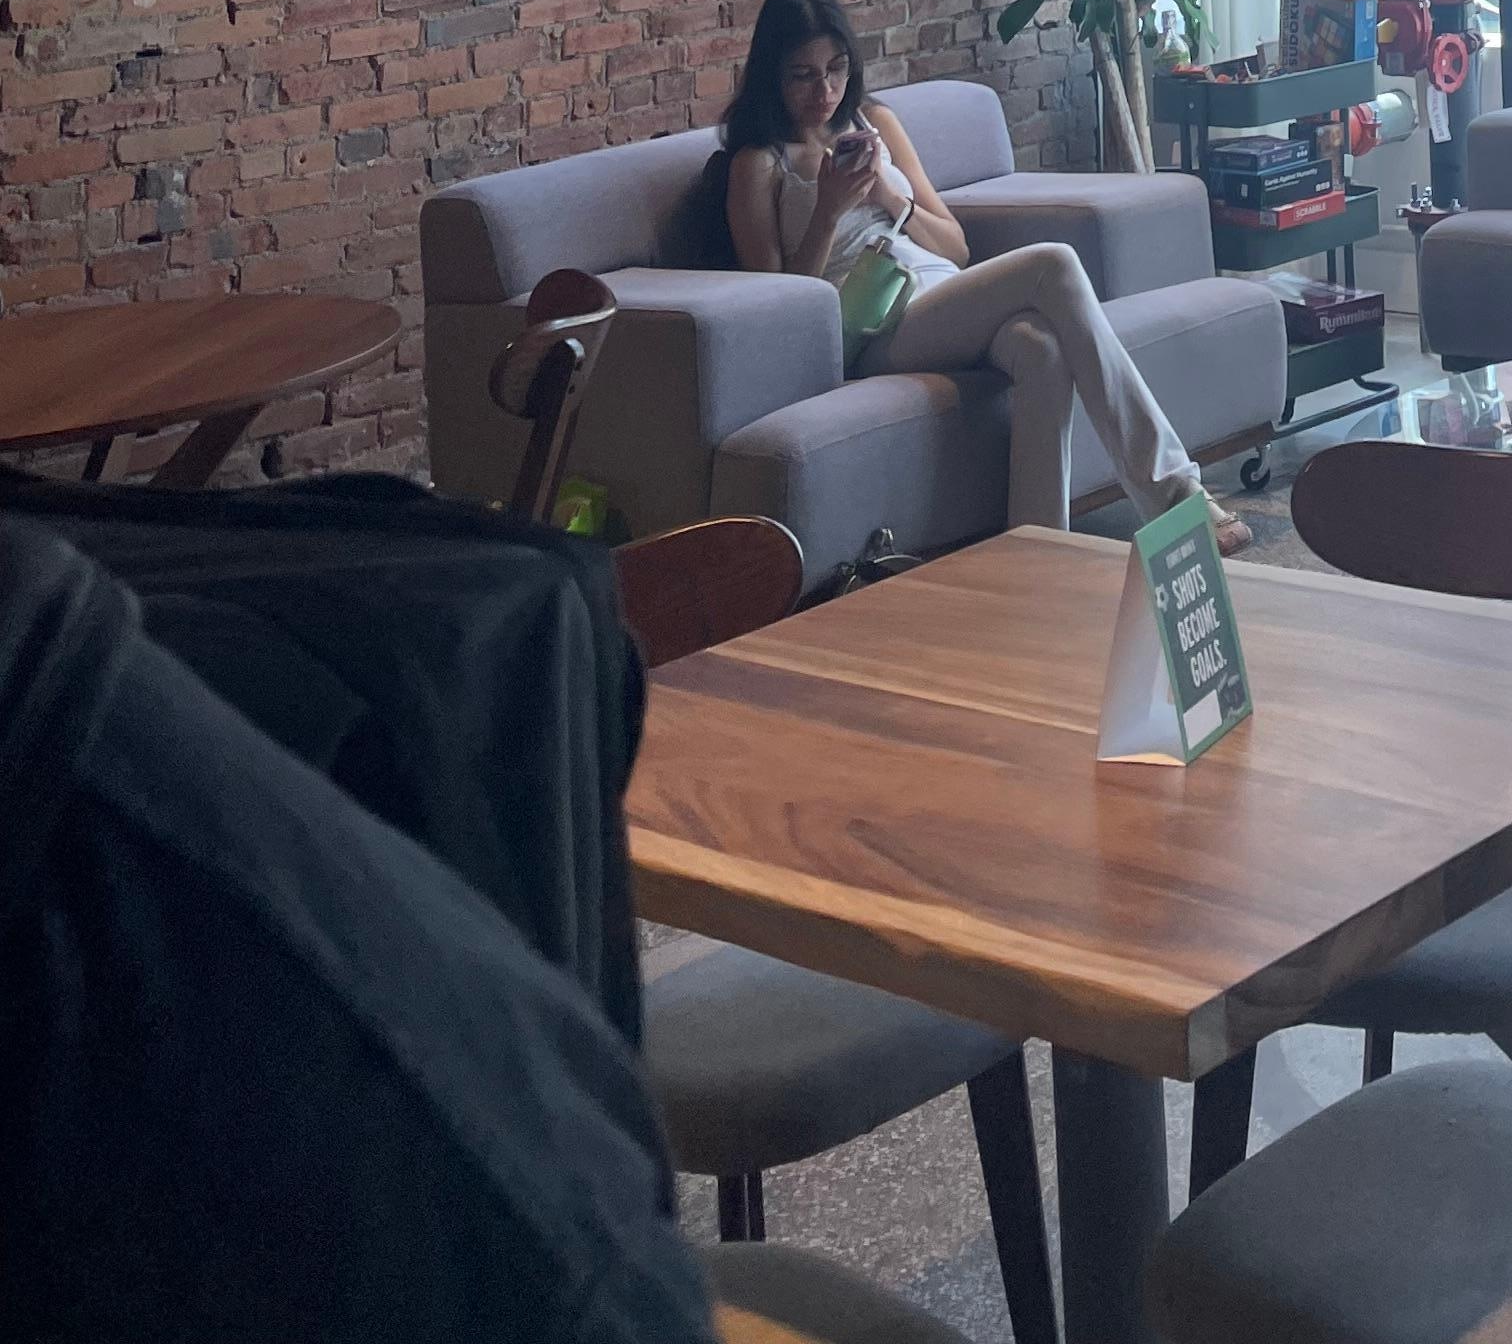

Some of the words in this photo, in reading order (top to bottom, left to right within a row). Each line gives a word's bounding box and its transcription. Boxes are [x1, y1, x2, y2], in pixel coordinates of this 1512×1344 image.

[1171, 563, 1207, 611] SHOTS
[1177, 597, 1221, 653] BECOME
[1189, 639, 1228, 688] GOALS.
